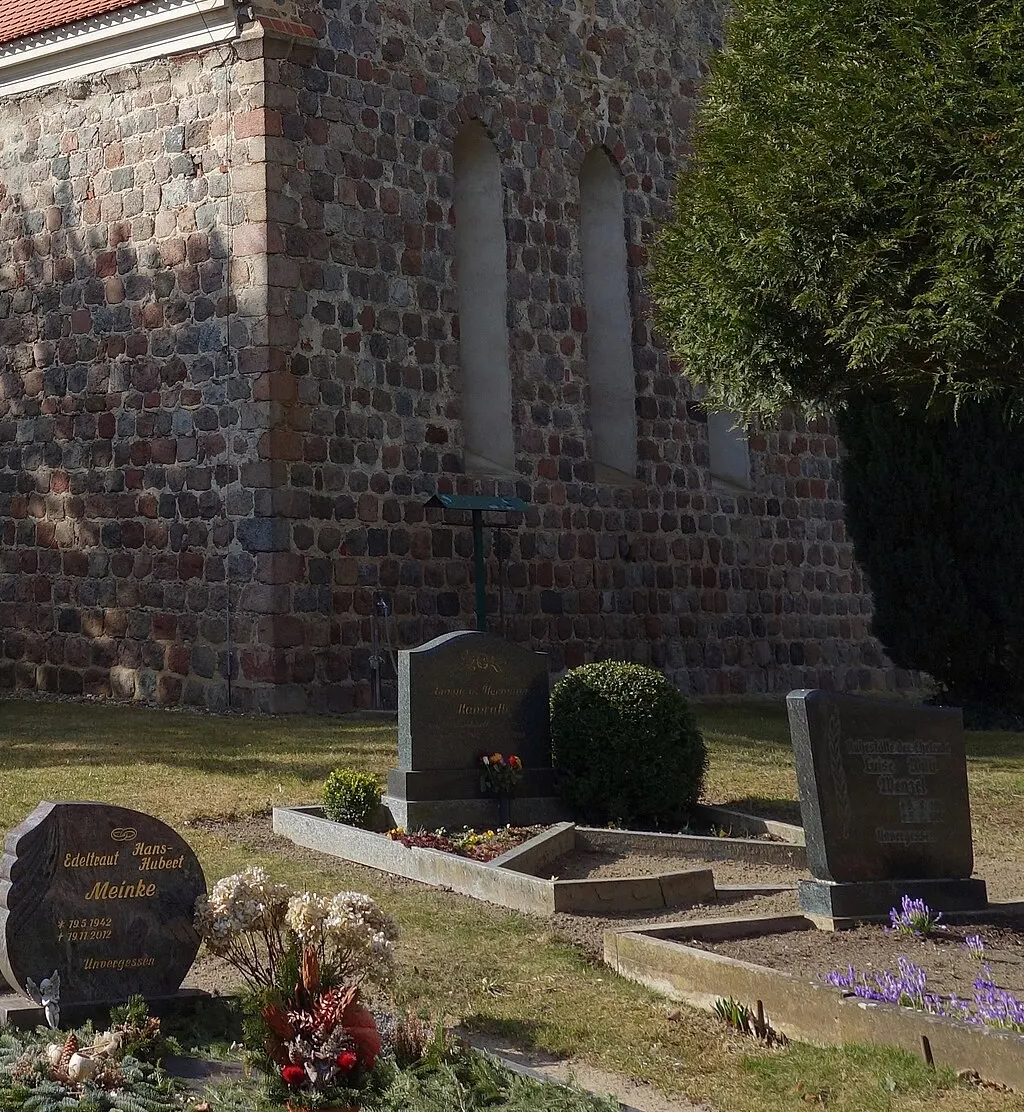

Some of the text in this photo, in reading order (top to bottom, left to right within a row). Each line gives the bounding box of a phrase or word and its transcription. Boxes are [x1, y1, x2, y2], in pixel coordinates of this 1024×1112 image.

[63, 842, 173, 868] Edeltraut Hans-
[138, 854, 185, 871] Hubert
[85, 878, 157, 901] Meinke
[83, 956, 156, 971] Unvergessen
